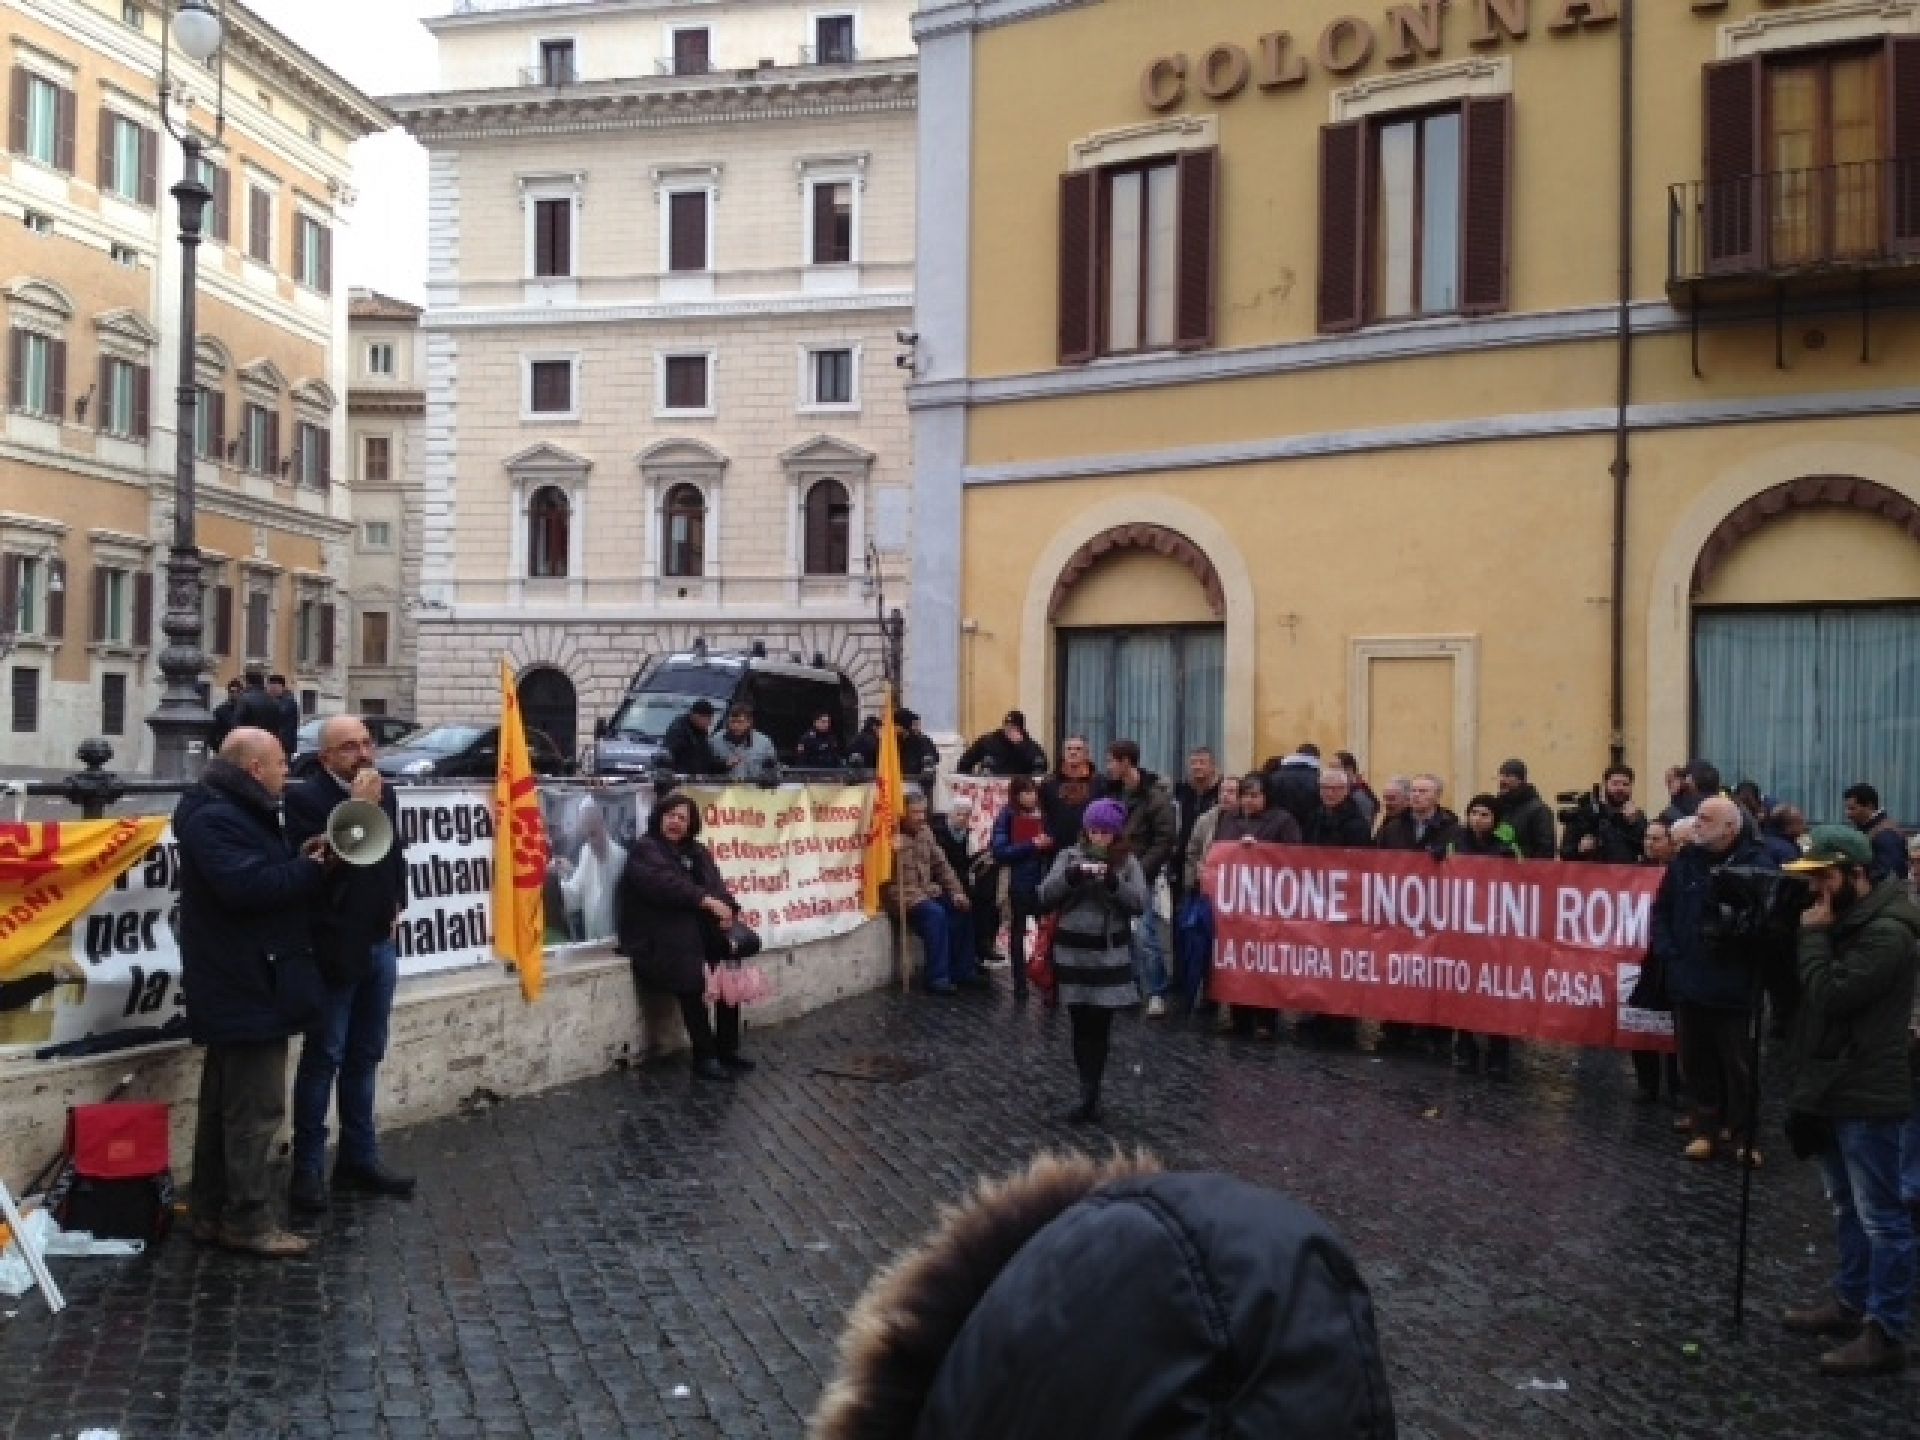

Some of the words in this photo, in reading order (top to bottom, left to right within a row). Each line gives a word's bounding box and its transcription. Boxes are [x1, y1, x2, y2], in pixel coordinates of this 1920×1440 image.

[1140, 0, 1620, 112] COLONNA
[402, 853, 496, 901] uban
[1217, 863, 1348, 922] UNIONE
[1361, 872, 1541, 938] INQUILINI
[1556, 887, 1653, 949] ROM
[86, 909, 162, 967] per
[121, 964, 173, 1018] la
[1213, 938, 1237, 970] LA
[1241, 941, 1333, 979] CULTURA
[1340, 947, 1381, 983] DEL
[1388, 952, 1471, 994] DIRITTO
[1475, 962, 1537, 1002] ALLA
[1544, 968, 1605, 1009] CASA
